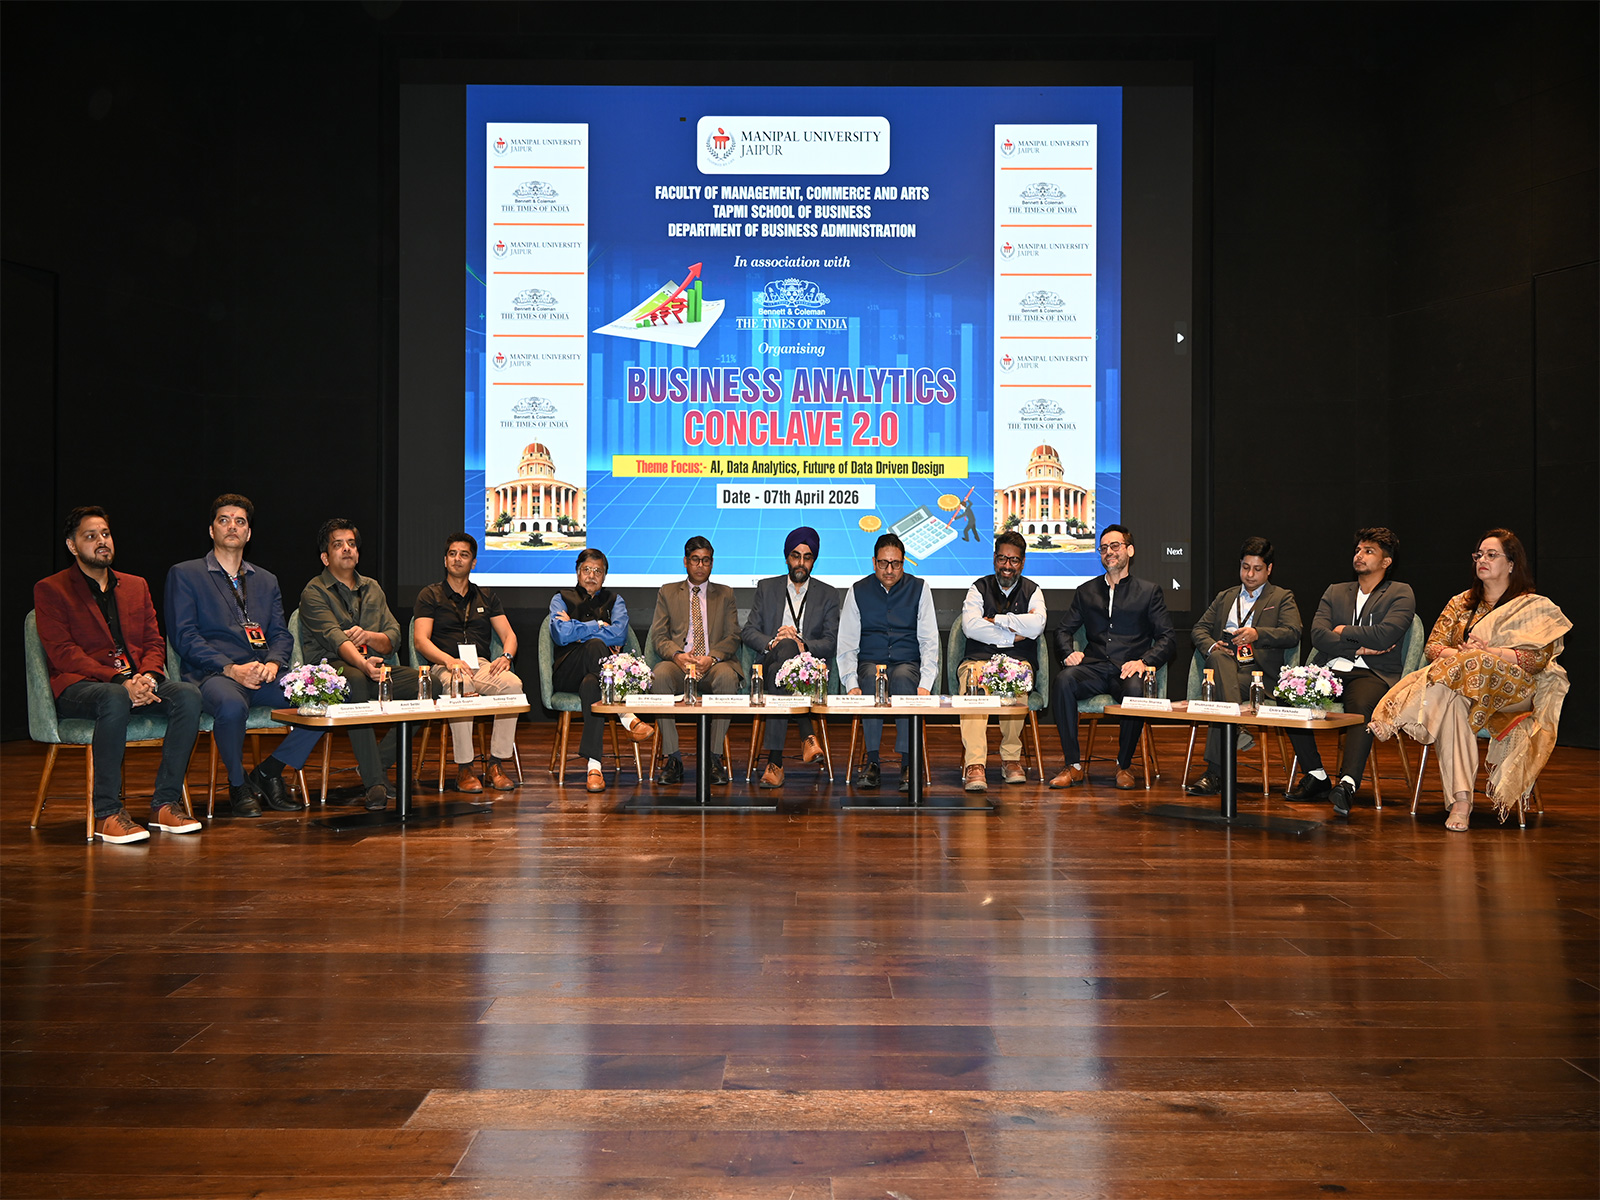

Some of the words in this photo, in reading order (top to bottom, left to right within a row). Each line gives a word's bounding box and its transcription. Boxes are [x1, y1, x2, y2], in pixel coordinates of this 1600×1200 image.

[740, 130, 800, 143] MANIPAL
[804, 130, 882, 143] UNIVERSITY
[510, 146, 532, 154] JAIPUR
[740, 144, 783, 158] JAIPUR
[1017, 147, 1040, 155] JAIPUR
[655, 186, 701, 200] FACULTY
[704, 186, 718, 200] OF
[721, 186, 803, 202] MANAGEMENT,
[806, 186, 871, 200] COMMERCE
[874, 186, 897, 200] AND
[900, 186, 930, 200] ARTS
[713, 204, 748, 219] TAPMI
[751, 205, 795, 219] SCHOOL
[798, 205, 812, 219] OF
[814, 205, 871, 219] BUSINESS
[668, 223, 741, 238] DEPARTMENT
[745, 223, 758, 237] OF
[761, 223, 818, 237] BUSINESS
[821, 224, 916, 238] ADMINISTRATION
[1017, 250, 1039, 258] JAIPUR
[734, 256, 748, 268] In
[751, 256, 820, 268] association
[823, 256, 851, 268] with
[758, 308, 786, 316] Bennett
[786, 308, 793, 316] &
[794, 308, 826, 316] Coleman
[736, 318, 761, 329] THE
[762, 318, 795, 329] TIMES
[797, 318, 814, 329] OF
[816, 318, 847, 329] INDIA
[758, 342, 826, 357] Organising
[509, 360, 532, 368] JAIPUR
[1017, 362, 1039, 370] JAIPUR
[627, 366, 782, 404] BUSINESS
[791, 367, 957, 405] ANALYTICS
[684, 409, 842, 446] CONCLAVE
[851, 410, 899, 447] 2.0
[636, 460, 669, 474] Theme
[671, 460, 707, 474] Focus:-
[710, 461, 724, 476] AI,
[727, 461, 749, 475] Data
[751, 461, 800, 476] Analytics,
[803, 461, 835, 475] Future
[838, 461, 849, 475] of
[850, 461, 873, 475] Data
[875, 461, 909, 475] Driven
[911, 462, 945, 477] Design
[723, 490, 752, 504] Date
[763, 490, 791, 504] 07th
[794, 490, 825, 506] April
[828, 490, 859, 504] 2026
[1166, 547, 1183, 556] Next
